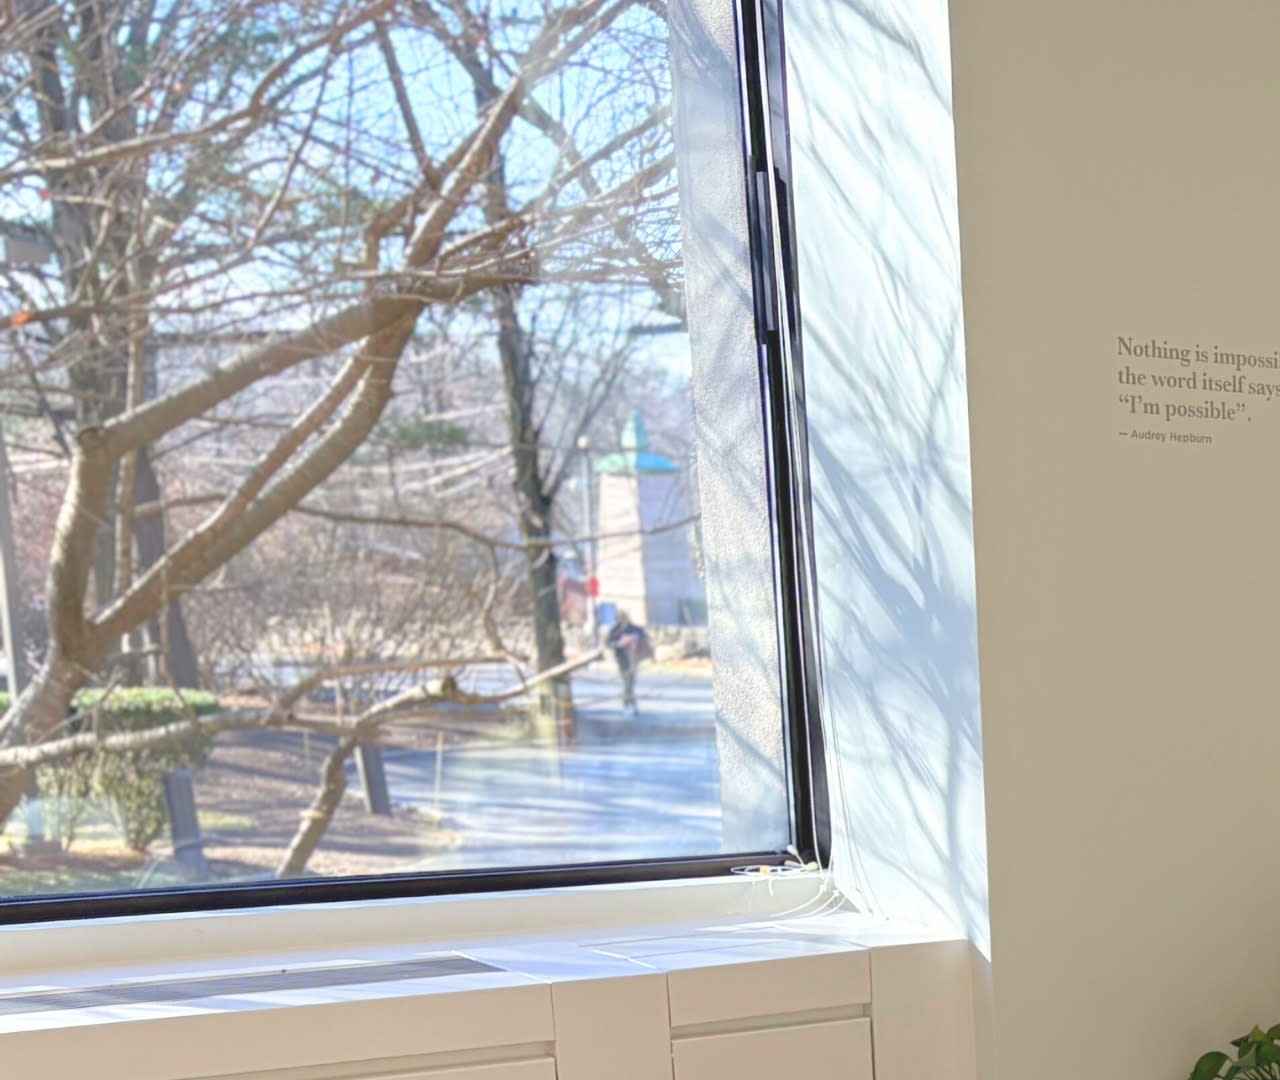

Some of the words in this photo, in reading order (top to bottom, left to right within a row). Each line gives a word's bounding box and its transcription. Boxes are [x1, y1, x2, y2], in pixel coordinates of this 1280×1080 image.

[1117, 335, 1191, 367] Nothing
[1195, 344, 1209, 362] is
[1118, 366, 1147, 385] the
[1151, 371, 1197, 390] word
[1202, 372, 1246, 394] itself
[1119, 394, 1160, 415] “I’m
[1131, 429, 1167, 443] Audrey
[1170, 432, 1213, 445] Hepburn
